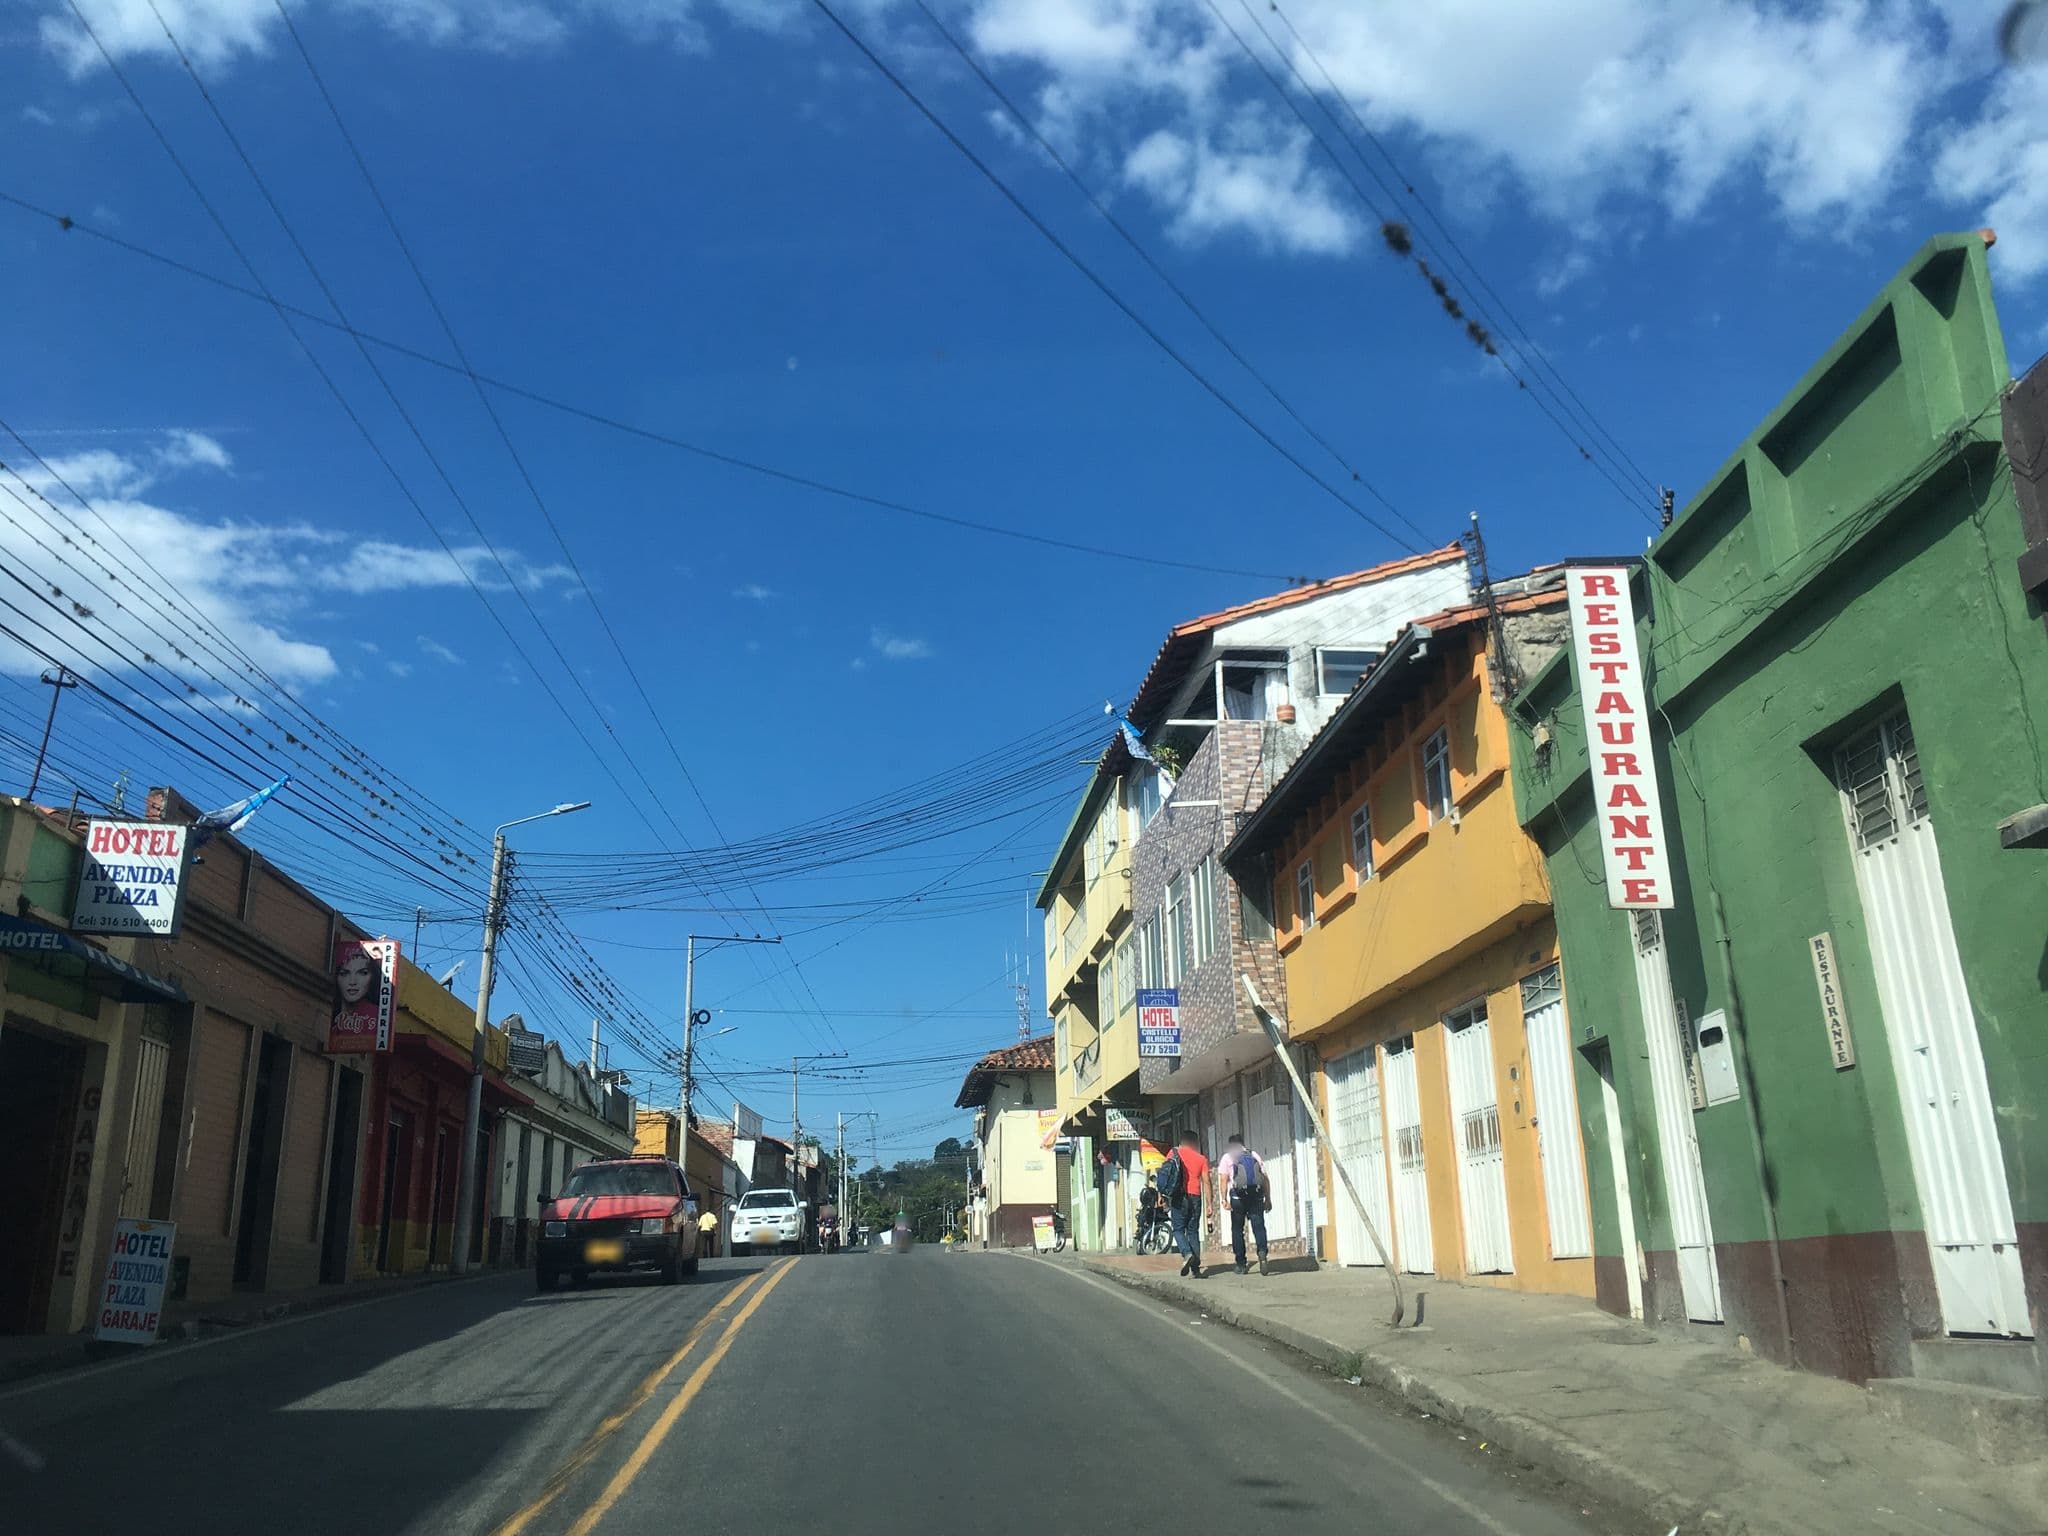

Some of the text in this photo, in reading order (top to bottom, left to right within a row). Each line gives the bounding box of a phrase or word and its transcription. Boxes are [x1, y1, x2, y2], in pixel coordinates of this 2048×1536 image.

[1580, 575, 1658, 903] RESTAURANTE
[91, 827, 180, 857] HOTEL
[84, 863, 176, 885] AVENIDA
[92, 886, 158, 906] PLAZA
[78, 915, 169, 928] Cel: 316 510 4400
[0, 931, 64, 950] HOTEL
[378, 945, 391, 1049] PELUQUERIA
[1814, 939, 1847, 1063] RESTAURANTE
[1143, 1008, 1176, 1027] HOTEL
[1143, 1045, 1156, 1054] 727
[1676, 1002, 1700, 1106] RESTAURANTE
[57, 1087, 100, 1277] GARAJE
[115, 1232, 168, 1258] HOTEL
[109, 1261, 163, 1284] AVENIDA
[106, 1284, 145, 1306] PLAZA
[101, 1309, 157, 1331] GARAJE
